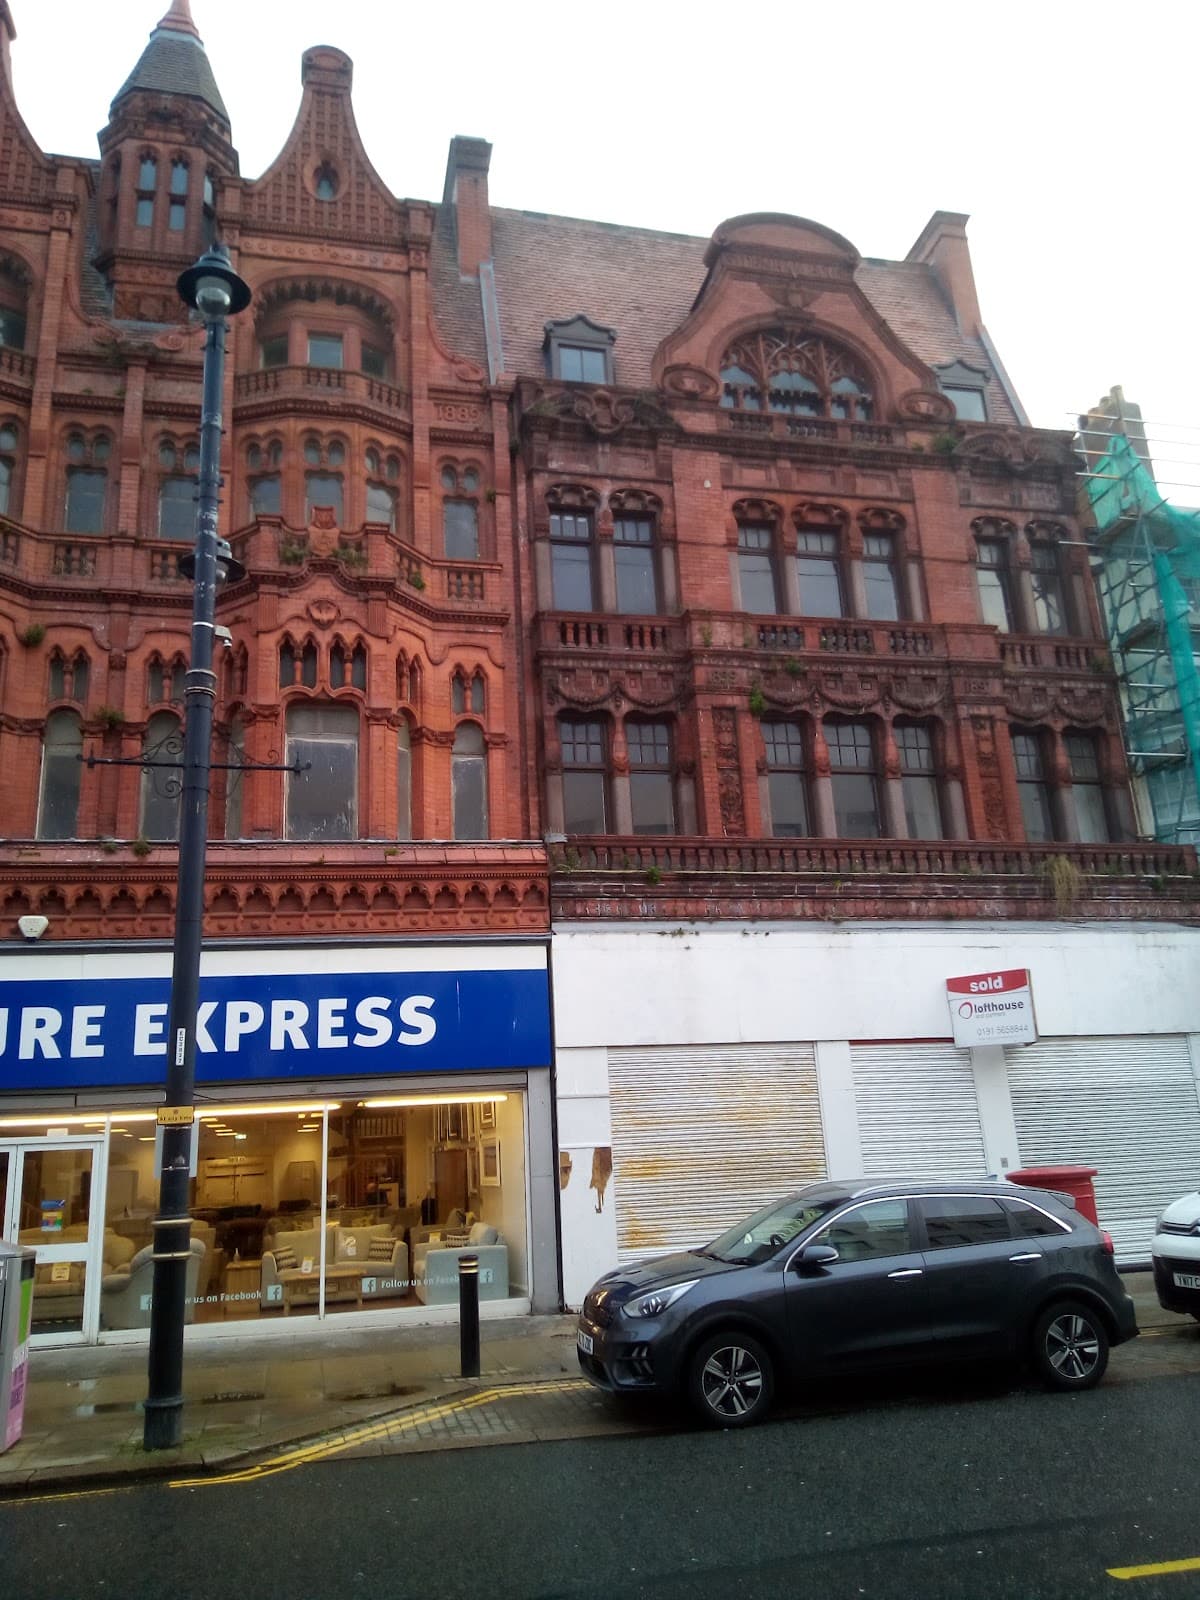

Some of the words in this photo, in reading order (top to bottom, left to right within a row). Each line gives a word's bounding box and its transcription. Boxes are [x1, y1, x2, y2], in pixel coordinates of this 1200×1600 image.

[969, 976, 1004, 993] sold
[974, 1001, 1024, 1013] lofthouse
[381, 1279, 410, 1289] Follow
[193, 1295, 204, 1304] us
[207, 1294, 218, 1303] on
[220, 1290, 262, 1302] Facebook
